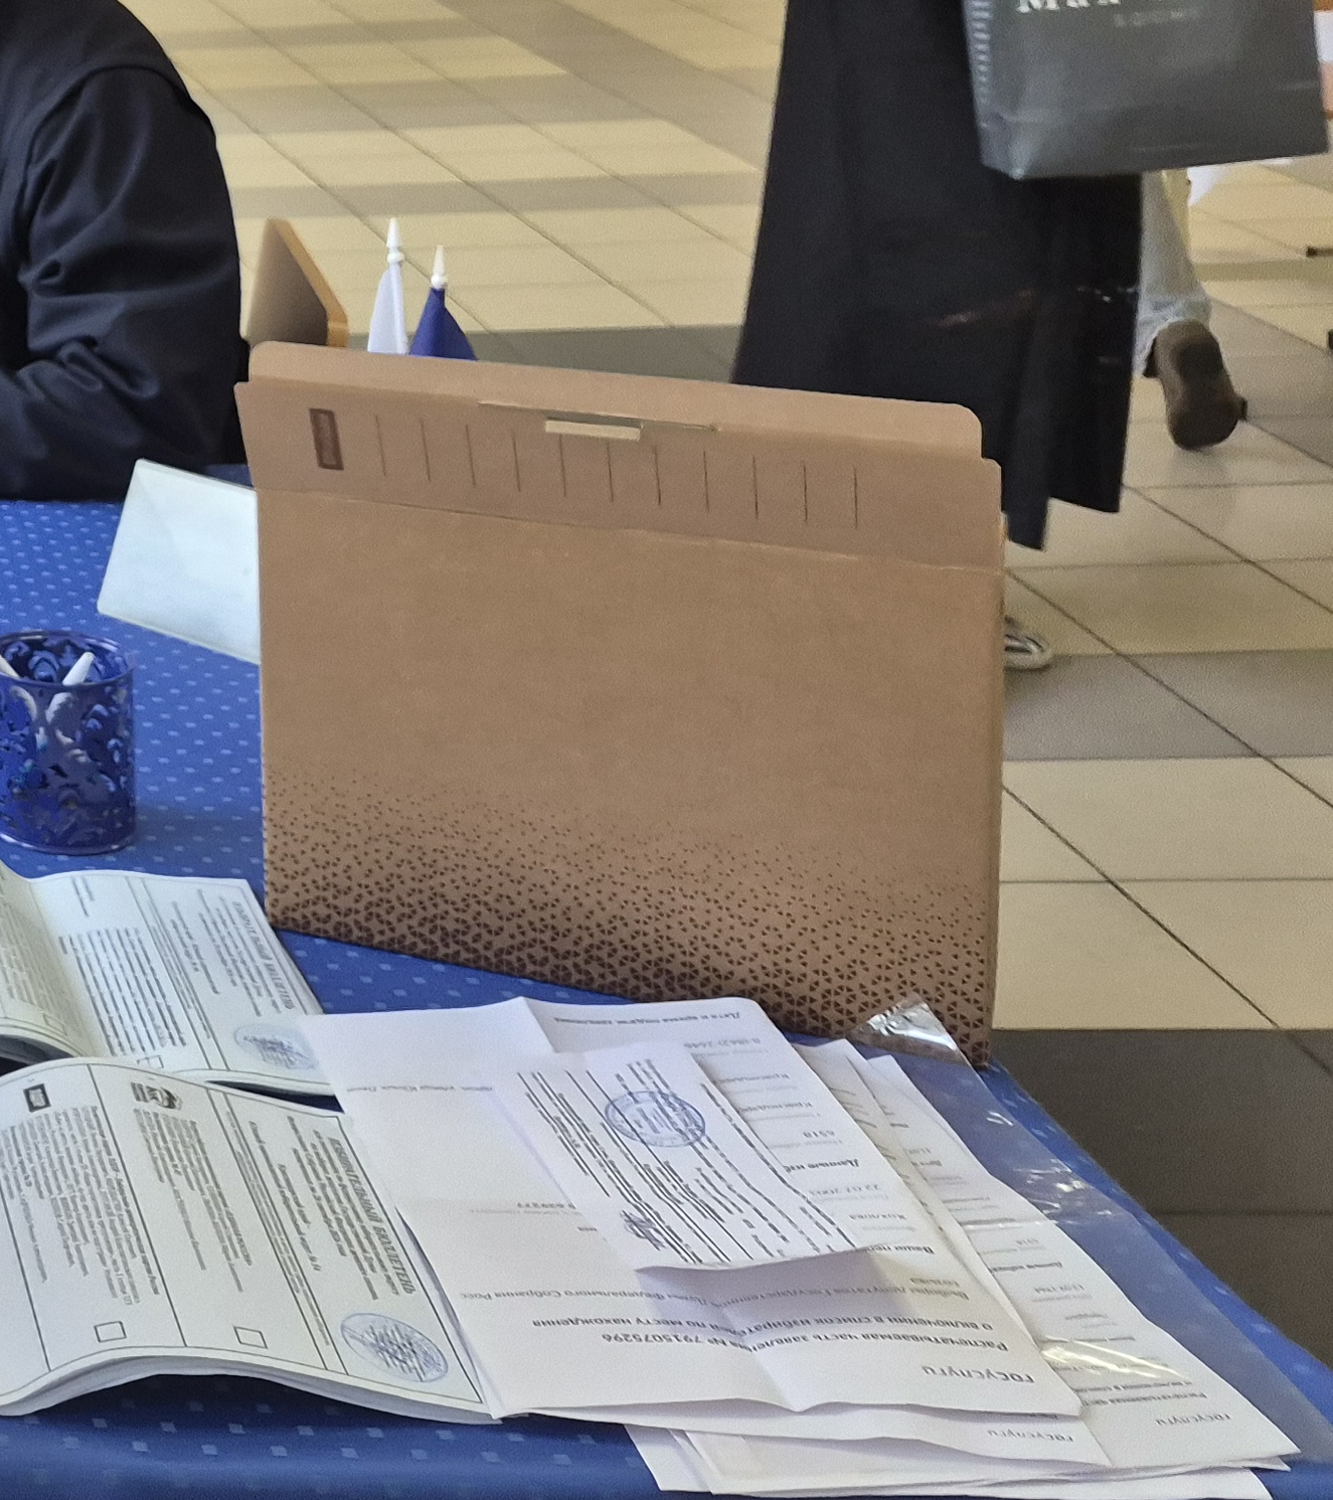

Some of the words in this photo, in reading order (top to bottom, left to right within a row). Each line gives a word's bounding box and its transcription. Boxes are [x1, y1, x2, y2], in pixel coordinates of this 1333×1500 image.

[531, 1315, 631, 1327] нахождения
[635, 1315, 682, 1326] месту
[684, 1319, 705, 1327] по
[813, 1315, 870, 1326] список
[811, 1332, 856, 1341] часть
[860, 1331, 1008, 1352] Распечатываемая
[920, 1364, 1034, 1384] госуслуги
[1155, 1412, 1230, 1426] госуслуги
[988, 1428, 1073, 1443] госуслуги
